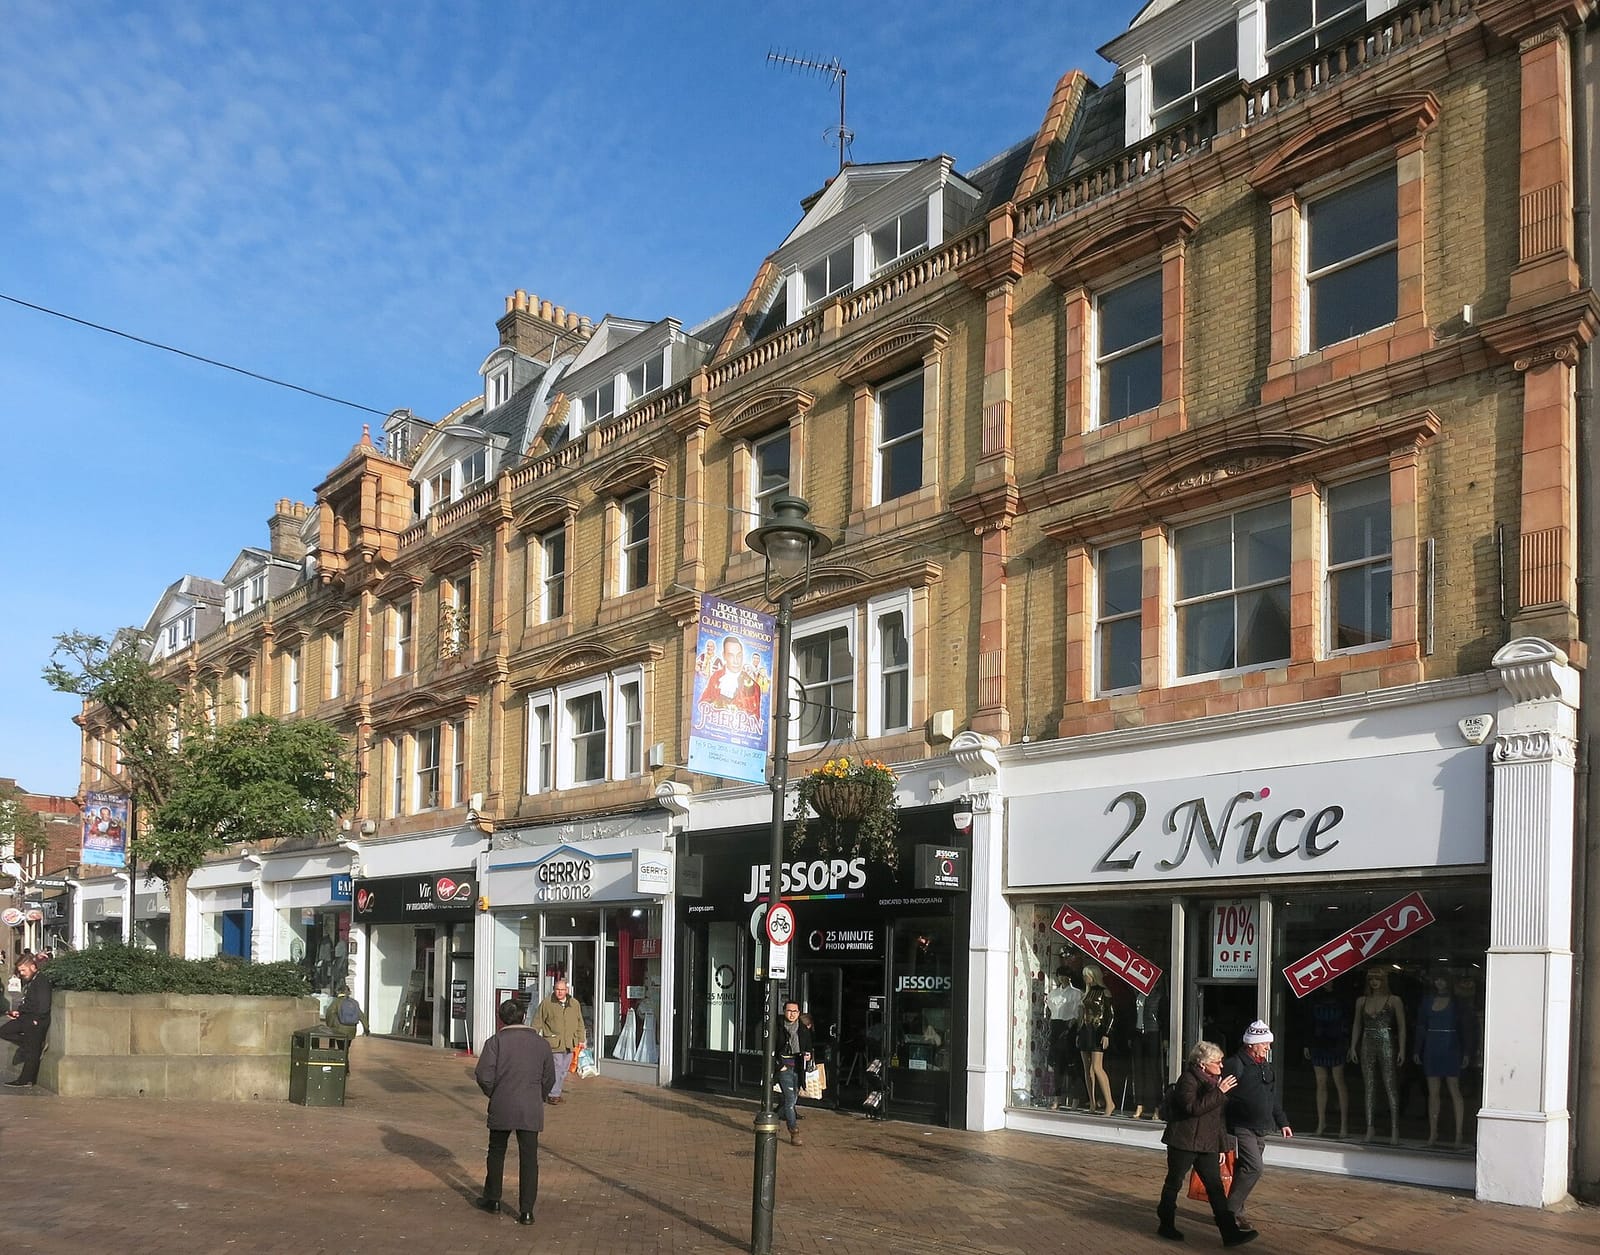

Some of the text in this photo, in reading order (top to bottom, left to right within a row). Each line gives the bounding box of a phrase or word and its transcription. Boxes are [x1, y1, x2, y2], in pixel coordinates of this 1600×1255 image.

[711, 608, 739, 623] TICKETS
[717, 602, 758, 621] HOOK YOUR
[1099, 787, 1344, 869] 2 Nice
[935, 850, 959, 859] JESSOPS
[538, 859, 592, 882] GERRYS
[640, 865, 668, 875] GERRYS
[743, 857, 867, 903] JESSOPS
[538, 883, 592, 901] at home
[688, 905, 715, 913] jessops.com
[879, 898, 902, 906] DEDICATED
[910, 897, 943, 905] PHOTOGRAPHY
[1217, 906, 1254, 945] 70%
[642, 940, 657, 948] SALE
[825, 930, 874, 942] 25 MINUTE
[846, 942, 874, 950] PRINTING
[1062, 912, 1154, 987] SALE
[1293, 905, 1424, 989] SALE
[1220, 951, 1252, 962] OFF
[896, 975, 951, 992] JESSOPS
